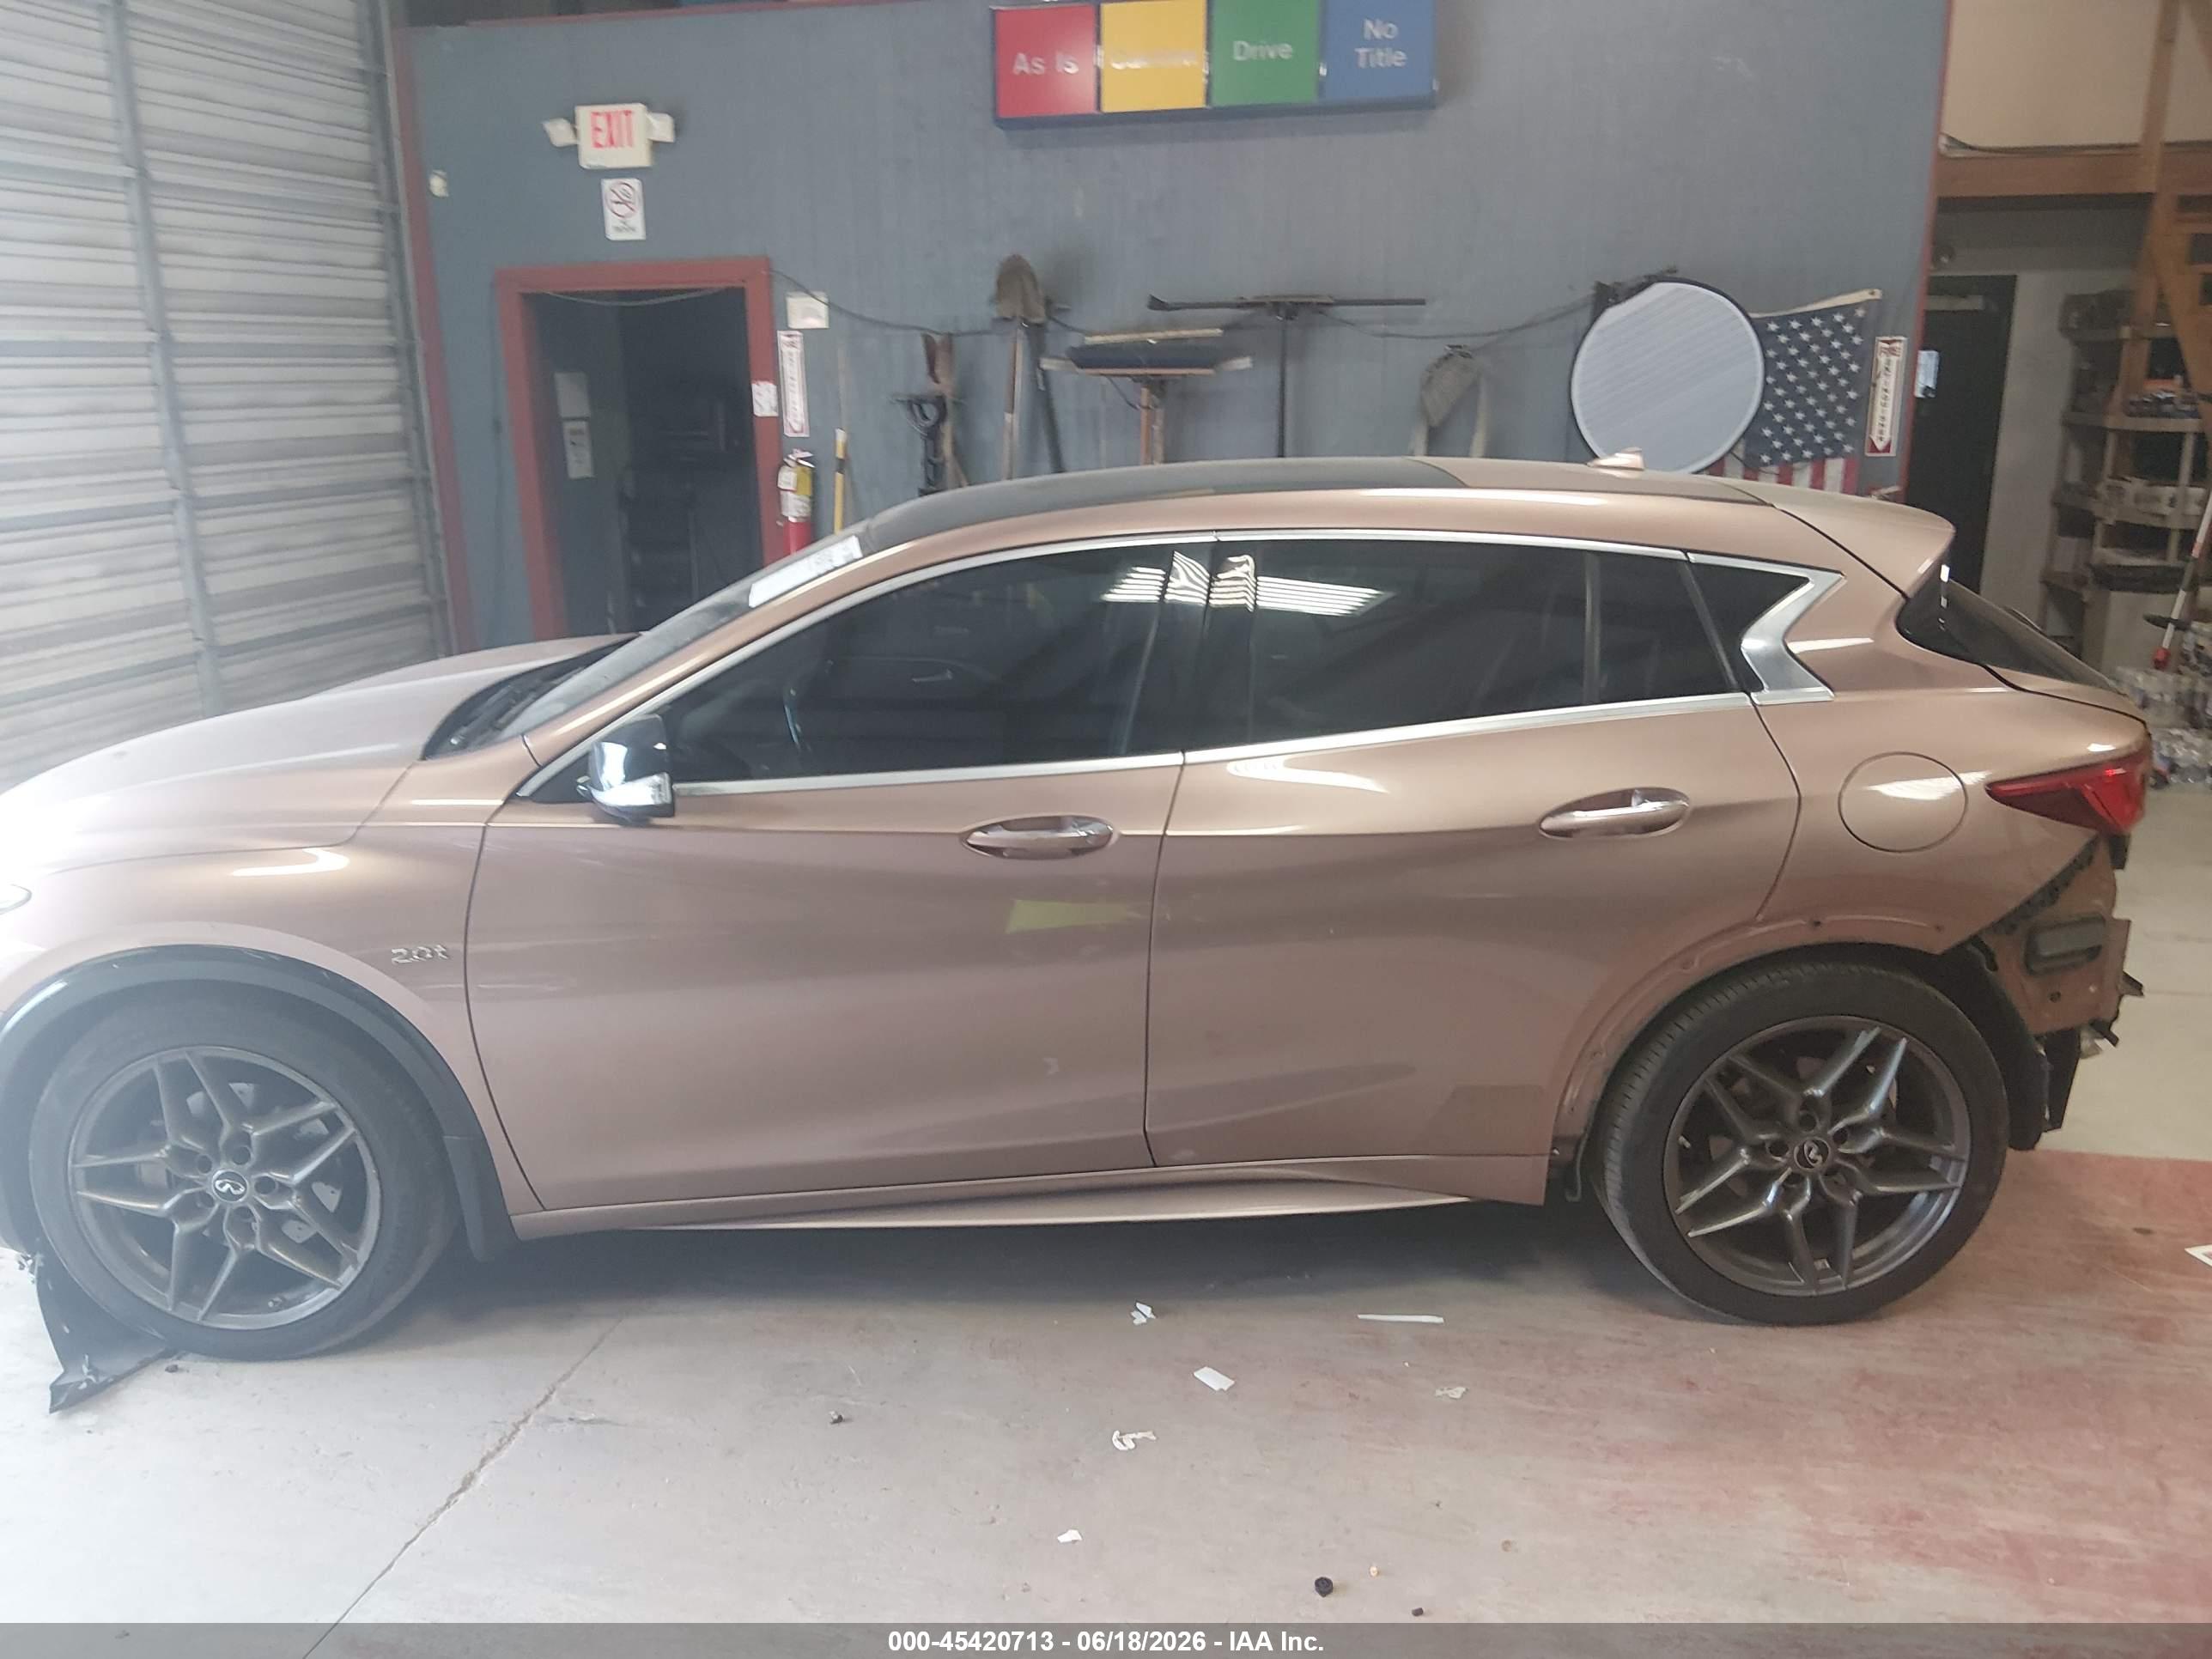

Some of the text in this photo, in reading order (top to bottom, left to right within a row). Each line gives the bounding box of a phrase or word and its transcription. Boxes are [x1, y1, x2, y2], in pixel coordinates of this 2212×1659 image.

[1364, 18, 1398, 40] No
[1233, 40, 1293, 61] Drive
[1355, 47, 1407, 69] Title
[1013, 52, 1044, 75] As
[591, 110, 634, 149] EXIT
